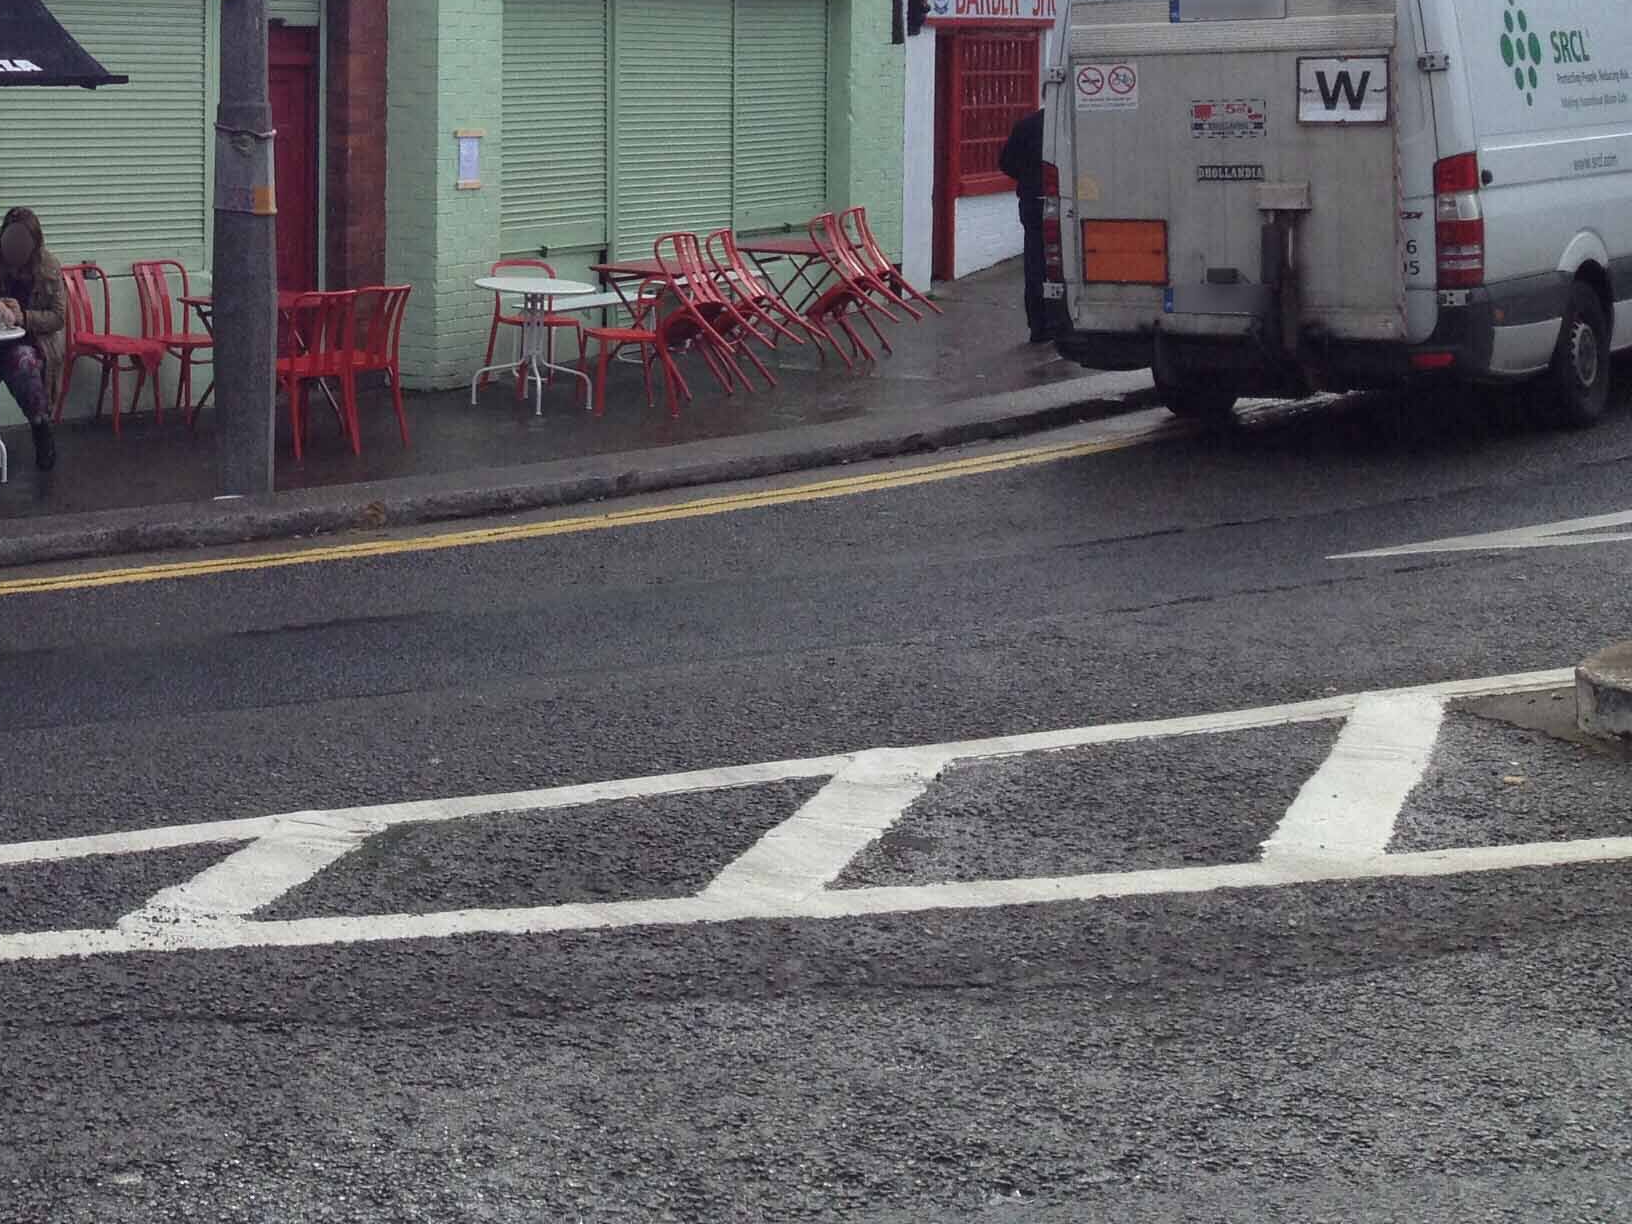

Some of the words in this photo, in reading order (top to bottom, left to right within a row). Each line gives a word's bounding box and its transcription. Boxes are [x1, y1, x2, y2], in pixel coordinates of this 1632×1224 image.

[1549, 29, 1591, 64] SRCL
[1315, 70, 1371, 111] W
[1199, 167, 1263, 178] DHOLLANDIA
